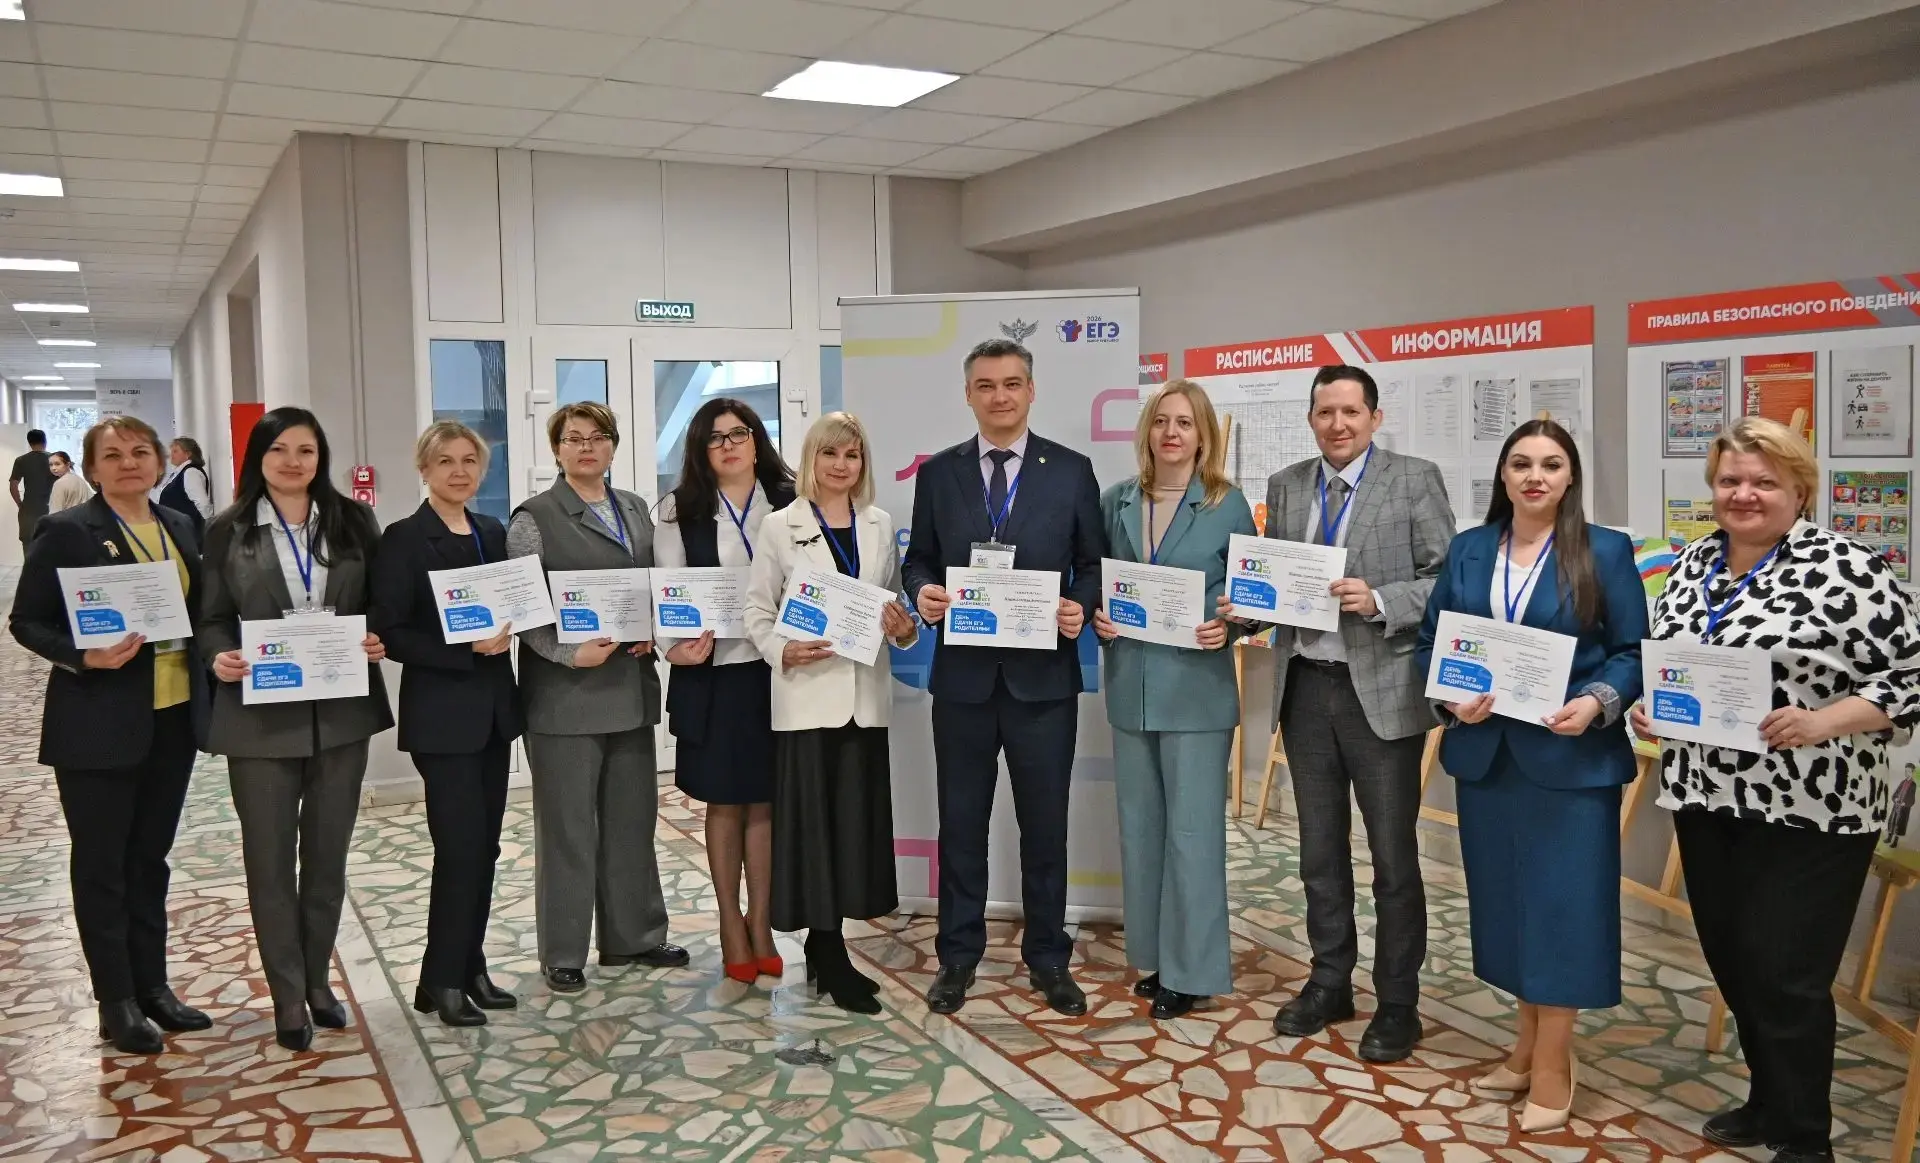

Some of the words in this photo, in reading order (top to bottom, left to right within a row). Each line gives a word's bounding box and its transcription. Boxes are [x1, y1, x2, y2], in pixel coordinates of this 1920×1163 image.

[642, 304, 691, 317] ВЫХОД
[1647, 311, 1710, 328] ПРАВИЛА
[1714, 298, 1827, 323] БЕЗОПАСНОГО
[1087, 322, 1120, 338] ЕГЭ
[1391, 319, 1542, 355] ИНФОРМАЦИЯ
[1216, 343, 1313, 370] РАСПИСАНИЕ
[1238, 558, 1262, 573] 100
[957, 588, 981, 601] 100
[1451, 638, 1478, 655] 100
